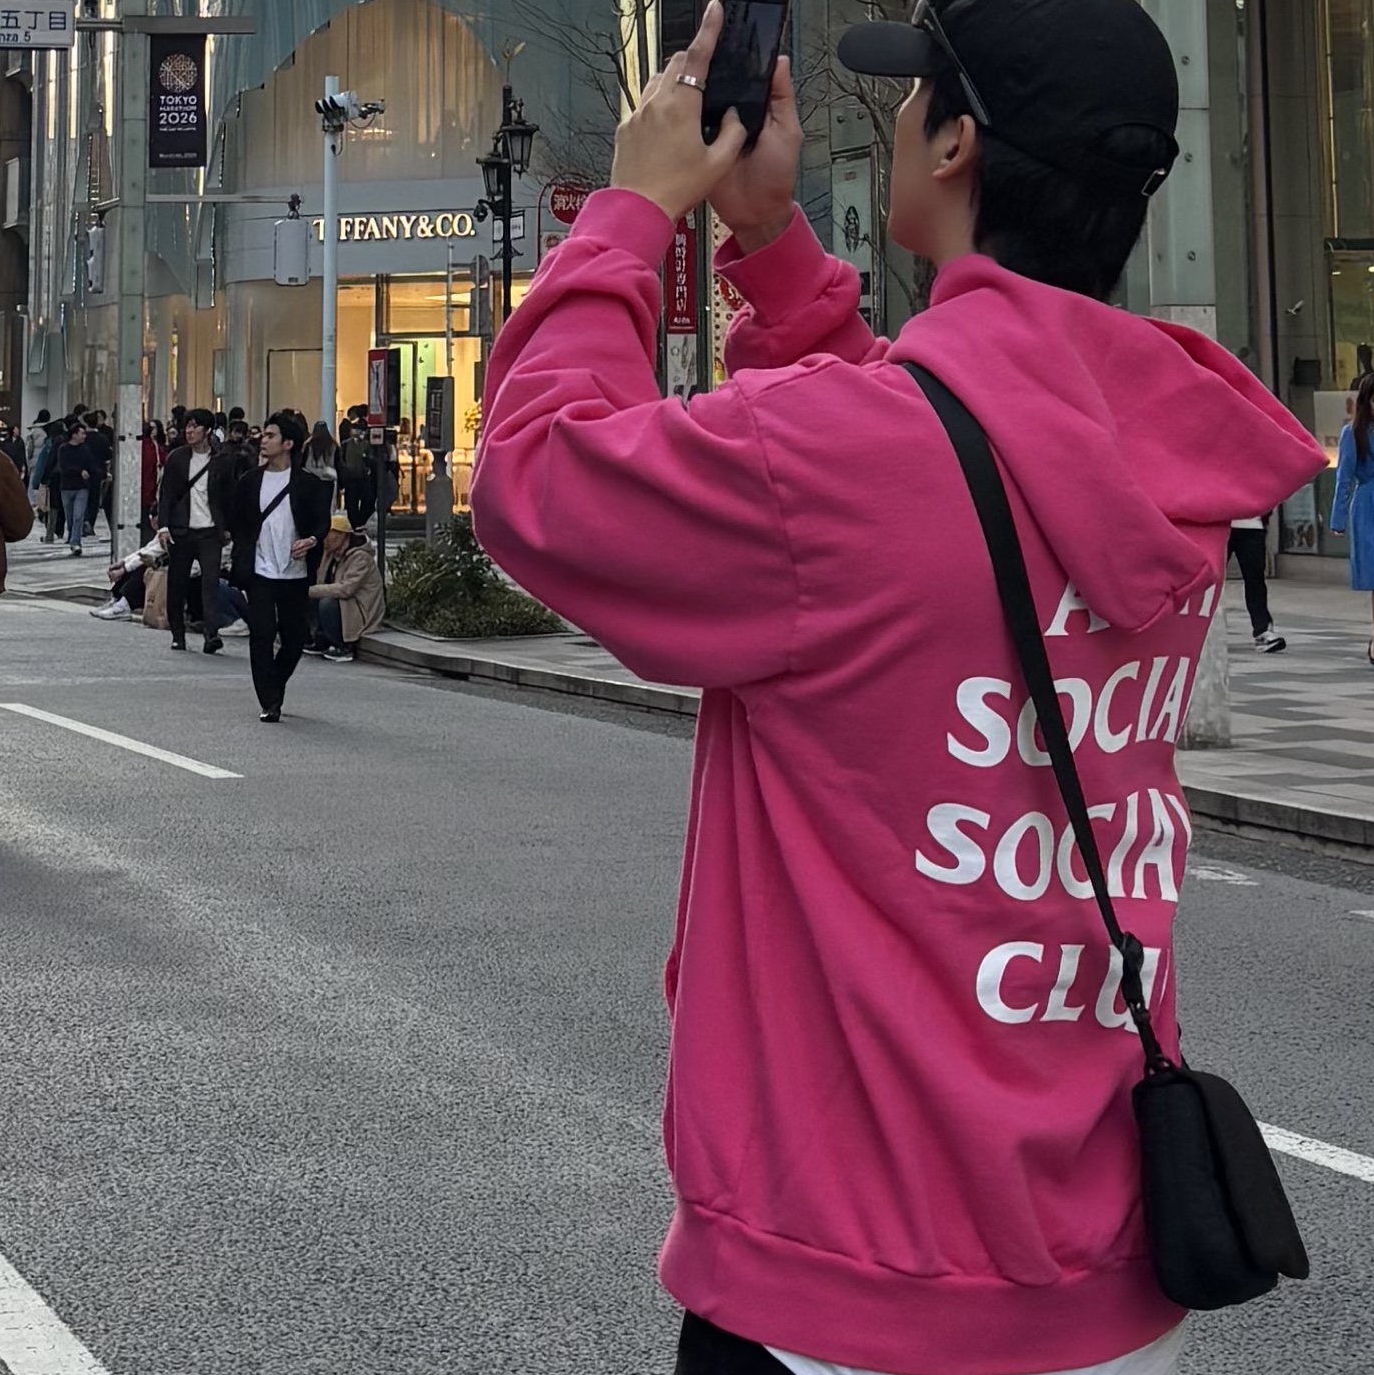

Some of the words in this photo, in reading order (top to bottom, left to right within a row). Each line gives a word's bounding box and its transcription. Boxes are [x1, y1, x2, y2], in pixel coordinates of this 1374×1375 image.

[24, 30, 32, 42] 5
[159, 96, 198, 105] TOKYO
[159, 112, 198, 125] 2026
[312, 213, 476, 241] TFFANY&CO.
[946, 655, 1194, 768] SOCIA
[975, 940, 1171, 1035] CLU
